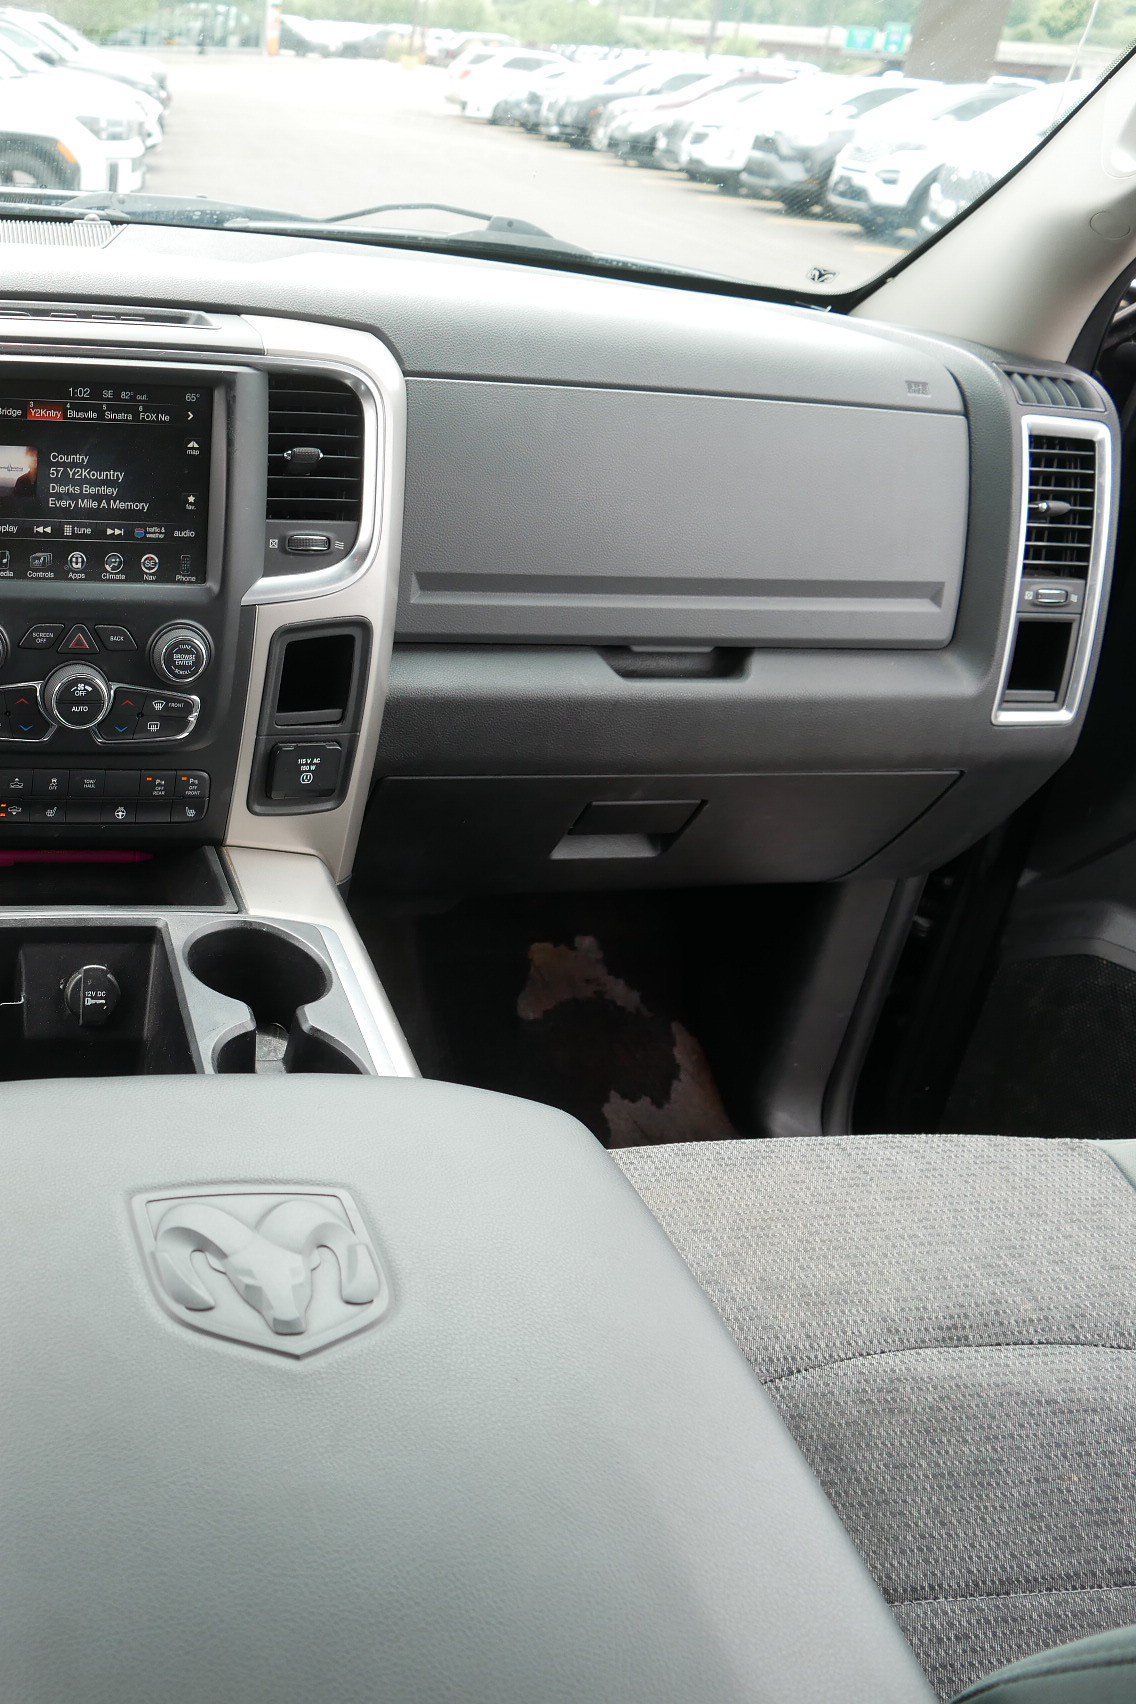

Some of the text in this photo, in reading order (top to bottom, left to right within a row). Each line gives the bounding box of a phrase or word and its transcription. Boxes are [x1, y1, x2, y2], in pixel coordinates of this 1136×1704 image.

[68, 387, 90, 398] 1:02
[103, 390, 114, 398] SE
[30, 408, 62, 419] Y2Kntry
[105, 411, 133, 420] Sinatra
[139, 413, 170, 421] FOX Ne
[187, 449, 199, 457] map
[50, 452, 89, 465] Country
[49, 467, 125, 482] 57 Y2Kountry
[49, 484, 118, 497] Dierks Bentley
[48, 498, 150, 512] Every Mile A Memory
[74, 526, 92, 534] tune
[173, 529, 196, 537] audio
[144, 560, 155, 568] SE
[68, 572, 85, 580] Apps
[101, 572, 126, 580] Climate
